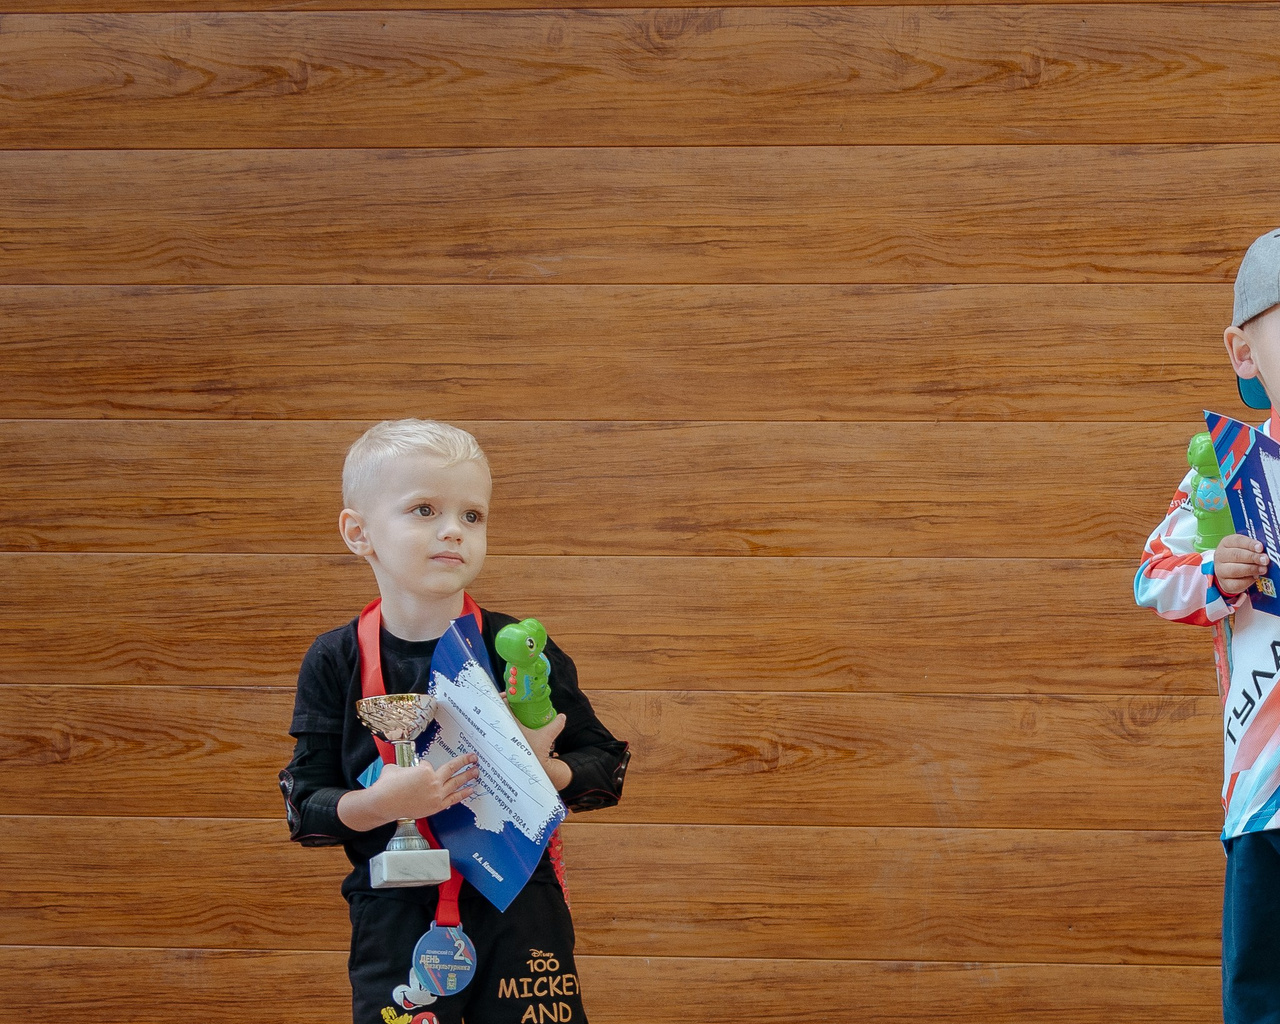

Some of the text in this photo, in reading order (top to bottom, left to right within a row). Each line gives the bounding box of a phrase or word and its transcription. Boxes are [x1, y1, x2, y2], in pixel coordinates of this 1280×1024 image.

[510, 736, 532, 756] место
[512, 813, 528, 831] 2024
[420, 954, 440, 964] ДЕНЬ
[454, 939, 466, 960] 2
[526, 958, 560, 973] 100
[520, 1001, 573, 1024] AND
